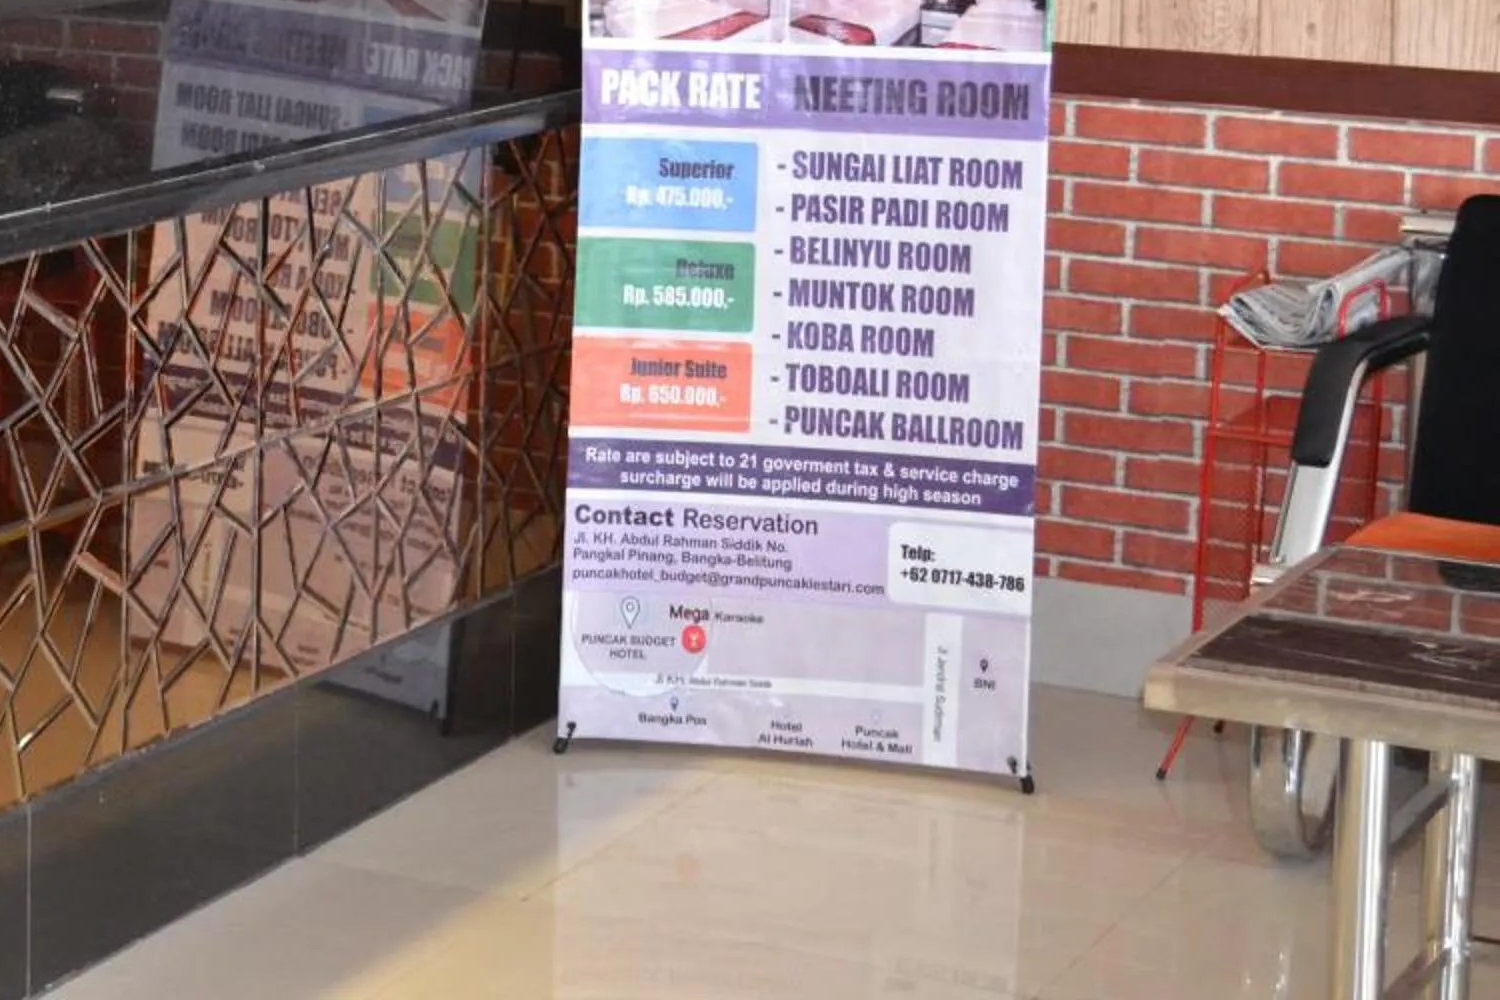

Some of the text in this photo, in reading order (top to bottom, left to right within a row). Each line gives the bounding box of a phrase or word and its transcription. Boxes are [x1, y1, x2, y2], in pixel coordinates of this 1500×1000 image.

[601, 68, 761, 111] PACK RATE
[793, 74, 1030, 121] MEETING ROOM
[659, 156, 735, 180] Superior
[792, 150, 1023, 190] SUNGAI LIAT ROOM
[791, 193, 1009, 232] PASIR PADI ROOM
[790, 236, 972, 274] BELINYU ROOM
[788, 278, 975, 317] MUNTOK ROOM
[787, 321, 935, 358] KOBA ROOM
[630, 358, 727, 380] Junior Suite
[786, 363, 970, 403] TOBOALI ROOM
[784, 405, 1023, 450] PUNCAK BALLROOM
[585, 447, 621, 463] Rate
[625, 449, 651, 463] are
[655, 449, 715, 469] subject
[719, 453, 735, 468] to
[739, 453, 758, 469] 21
[854, 460, 878, 477] tax
[883, 462, 896, 478] &
[900, 464, 959, 484] service
[962, 469, 1019, 490] charge
[619, 469, 981, 505] surcharge will be applied during high season
[575, 504, 819, 535] Contact Reservation
[573, 547, 625, 563] Pangkal
[593, 533, 617, 544] KH.
[620, 533, 660, 547] Abdul
[663, 535, 717, 549] Rahman
[721, 538, 762, 552] Siddik
[766, 541, 788, 553] No.
[900, 544, 935, 562] Telp:
[900, 566, 928, 583] +62
[669, 604, 710, 624] Mega
[581, 633, 676, 647] PUNCAK BUDGET
[609, 649, 647, 660] HOTEL
[638, 712, 683, 727] Bangka
[771, 719, 802, 733] Hotel
